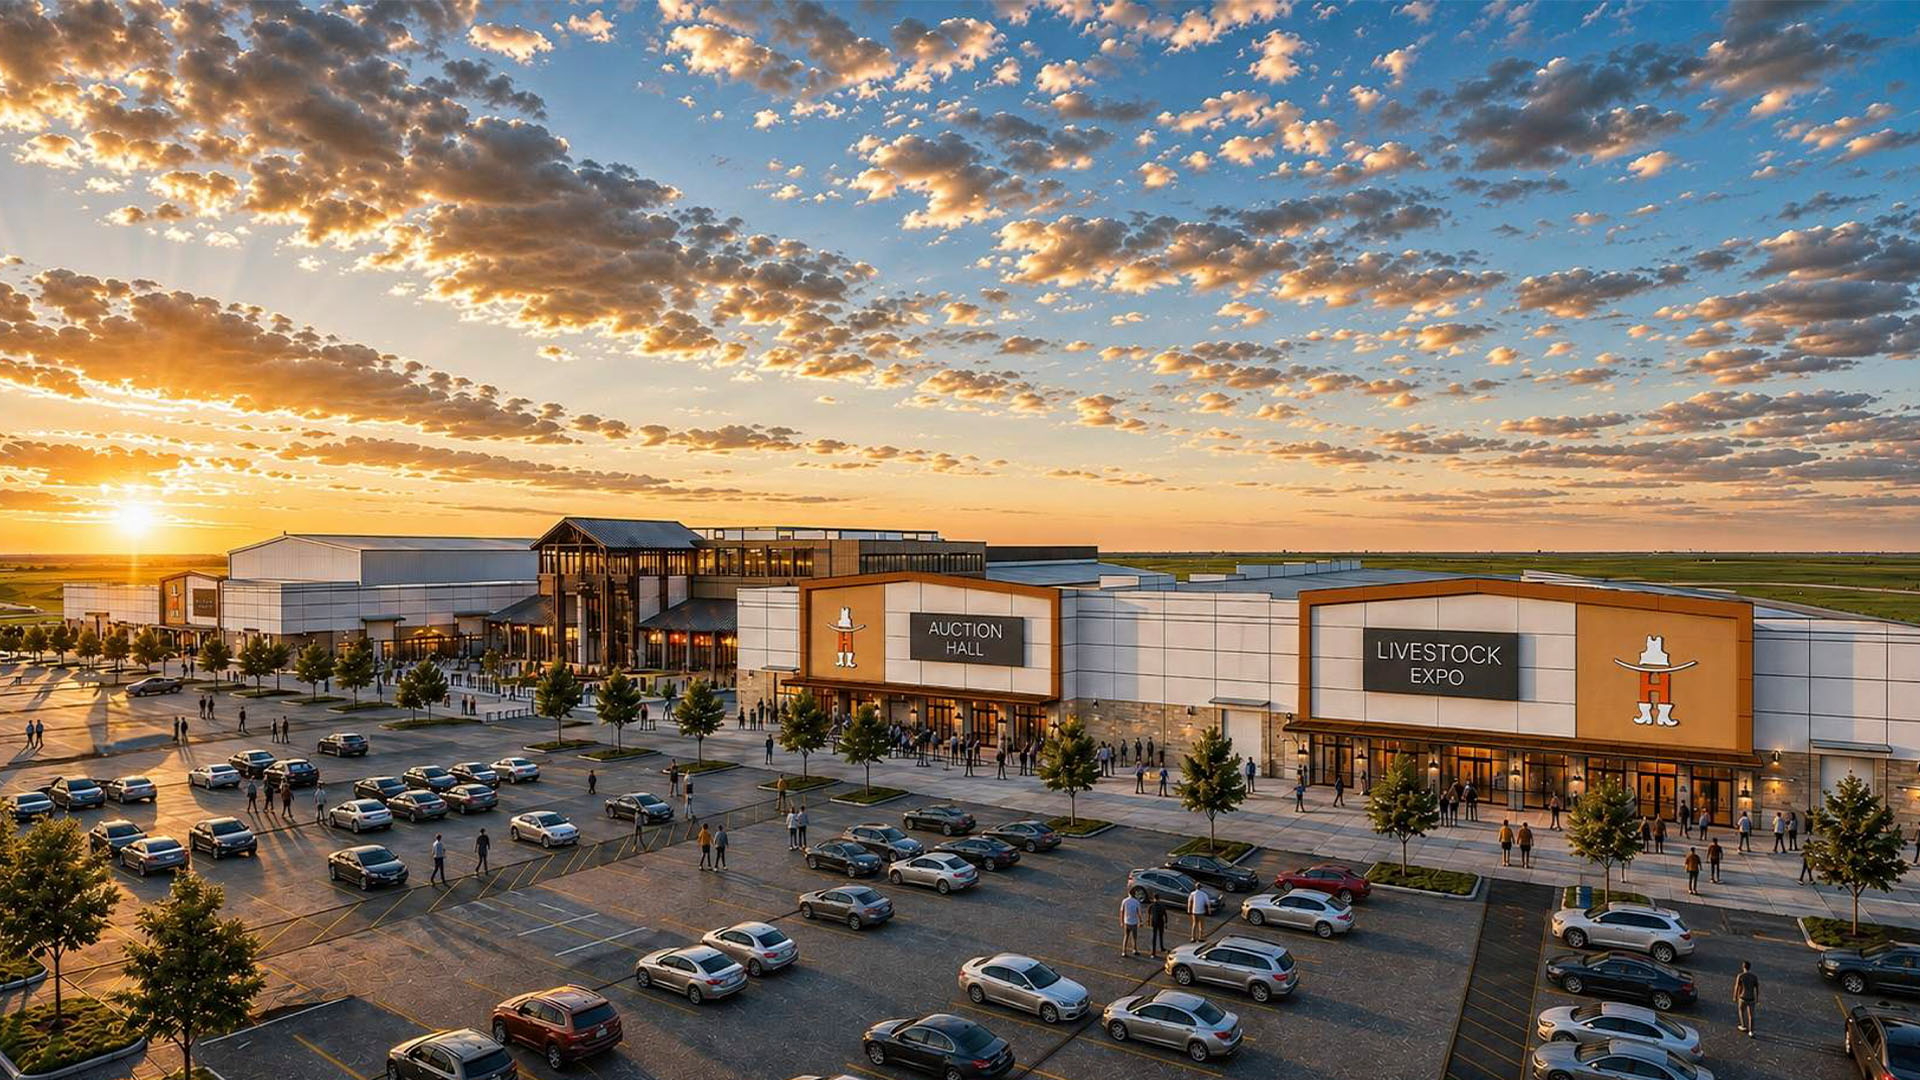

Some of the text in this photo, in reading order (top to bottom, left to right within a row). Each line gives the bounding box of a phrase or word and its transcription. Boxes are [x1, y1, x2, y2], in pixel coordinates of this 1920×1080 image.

[928, 621, 1002, 639] AUCTION
[946, 641, 984, 656] HALL
[1377, 641, 1502, 665] LIVESTOCK
[1410, 667, 1465, 686] EXPO
